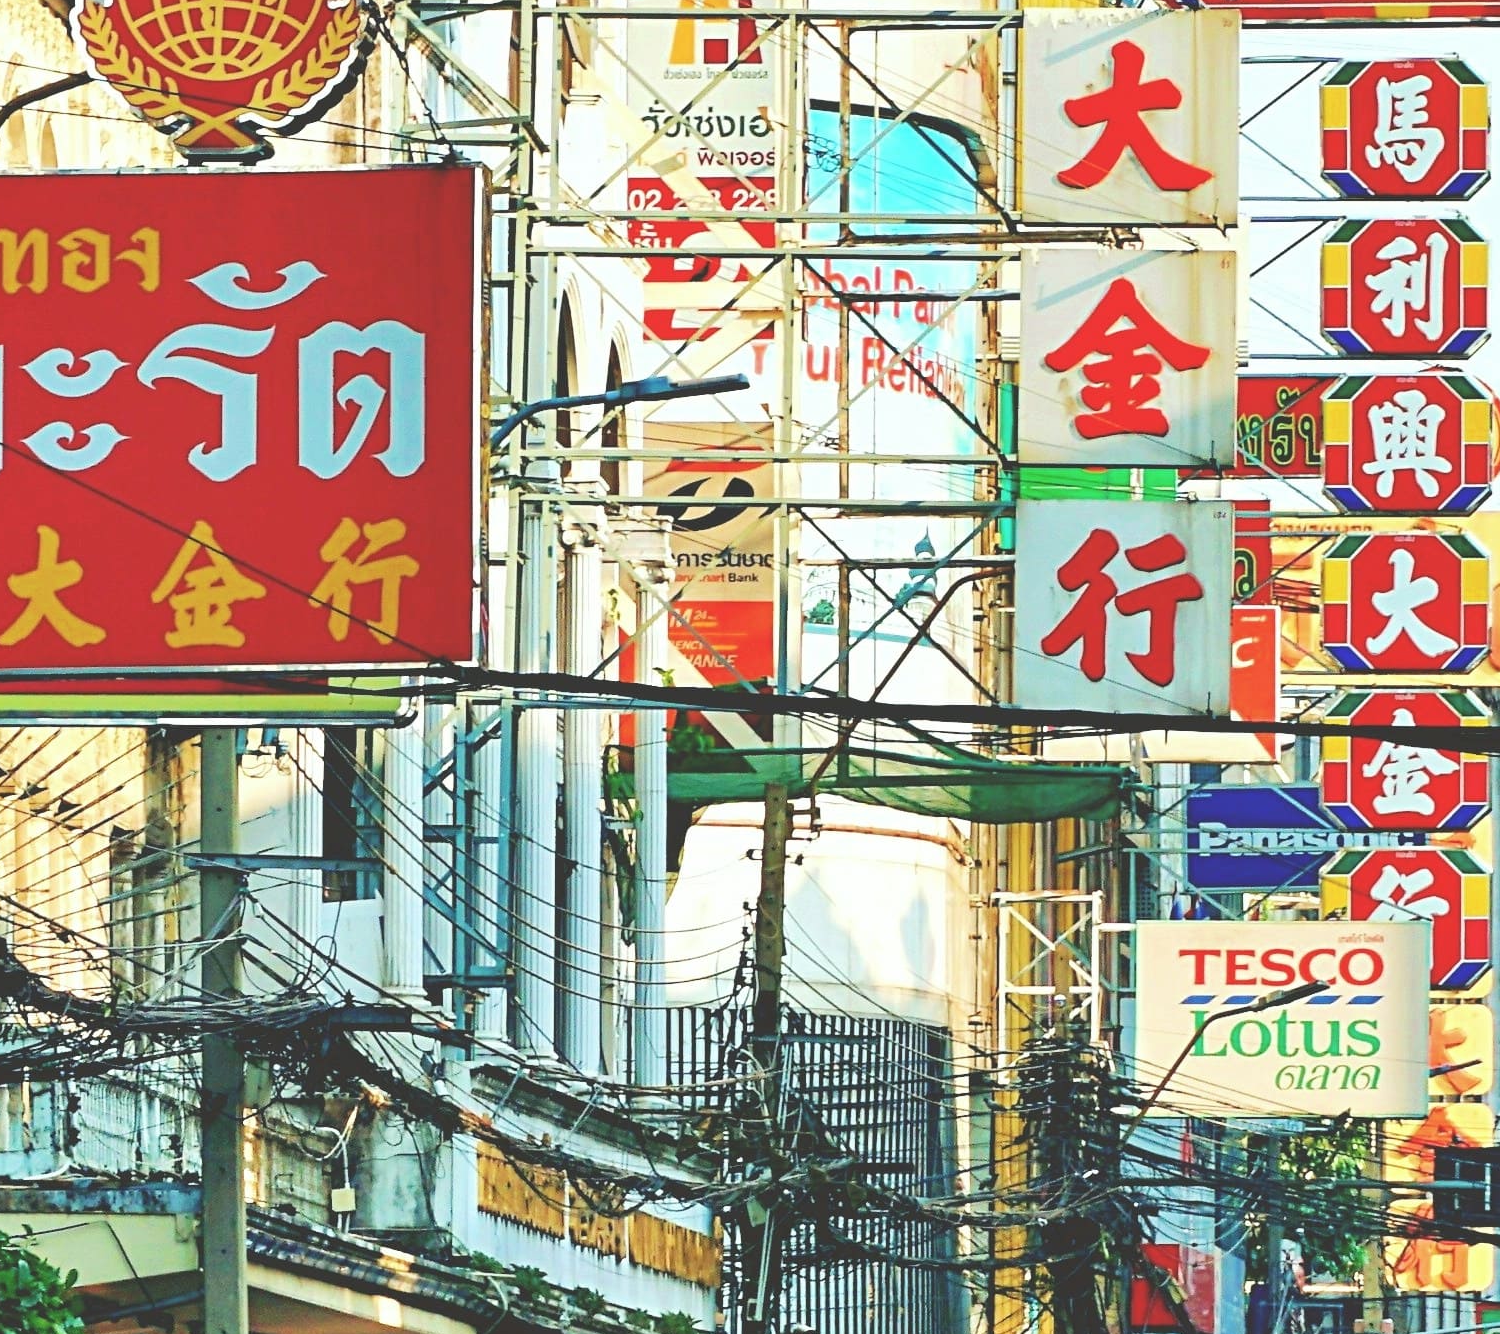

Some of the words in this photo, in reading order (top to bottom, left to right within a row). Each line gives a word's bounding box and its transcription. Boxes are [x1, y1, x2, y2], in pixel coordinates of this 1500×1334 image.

[727, 571, 759, 583] Bank
[1198, 821, 1416, 857] Panasonic
[1177, 948, 1386, 987] TESCO
[1188, 1008, 1381, 1058] Lotus
[1274, 1063, 1381, 1091] ตลาด
